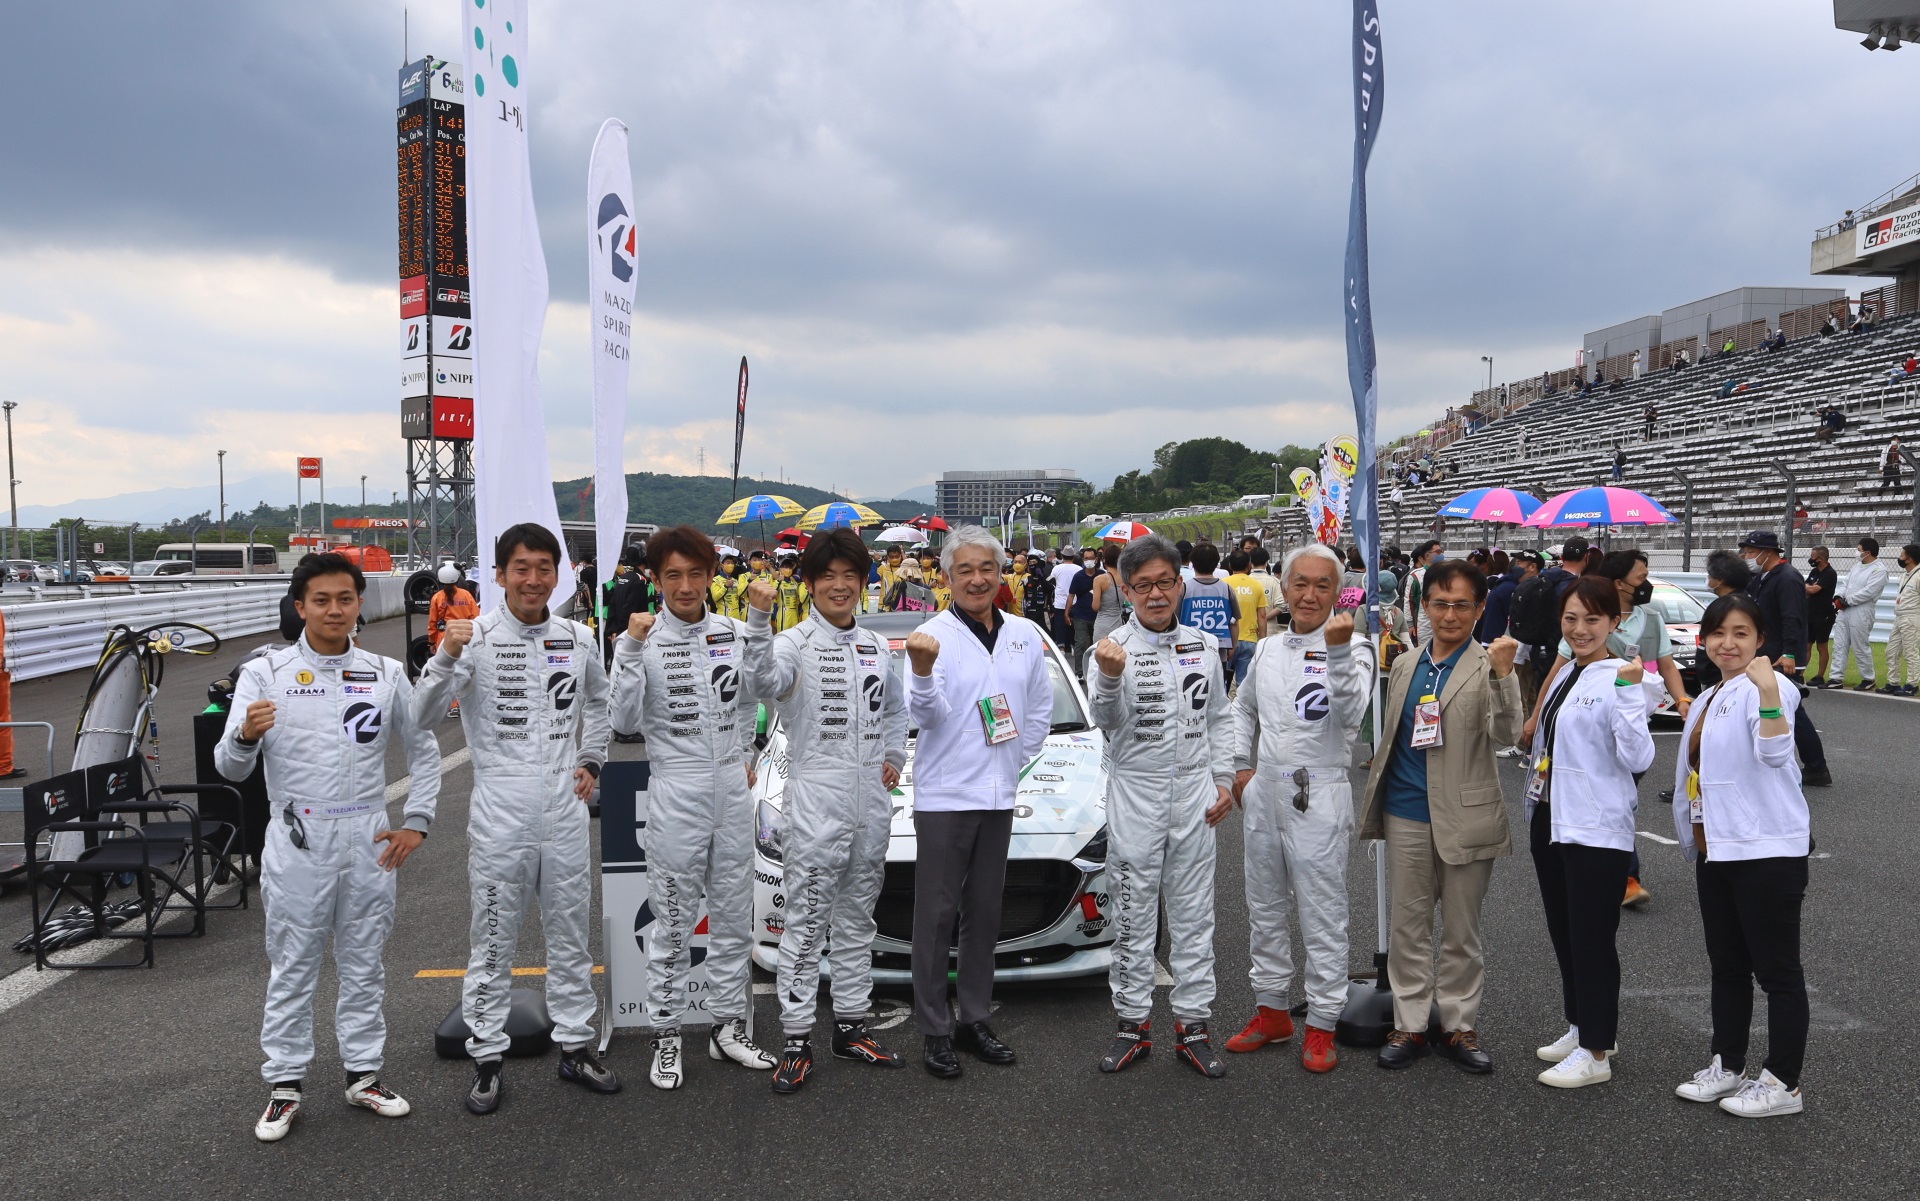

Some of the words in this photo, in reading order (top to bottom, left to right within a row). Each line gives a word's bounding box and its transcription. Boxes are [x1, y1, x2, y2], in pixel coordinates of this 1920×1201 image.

[433, 101, 452, 112] LAP
[437, 129, 453, 139] Pos.
[434, 141, 450, 154] 31
[1864, 229, 1891, 248] GR
[438, 293, 458, 302] GR
[604, 290, 631, 315] MAZD
[605, 339, 630, 361] RACIN
[408, 371, 425, 383] NIPPO
[1008, 494, 1057, 512] POTENZ
[1192, 599, 1225, 609] MEDIA
[1190, 610, 1229, 630] 562
[808, 866, 819, 916] MAZDA
[1119, 860, 1131, 911] MAZDA
[666, 876, 680, 927] MAZDA
[486, 885, 498, 937] MAZDA
[1075, 919, 1112, 932] SHORAI
